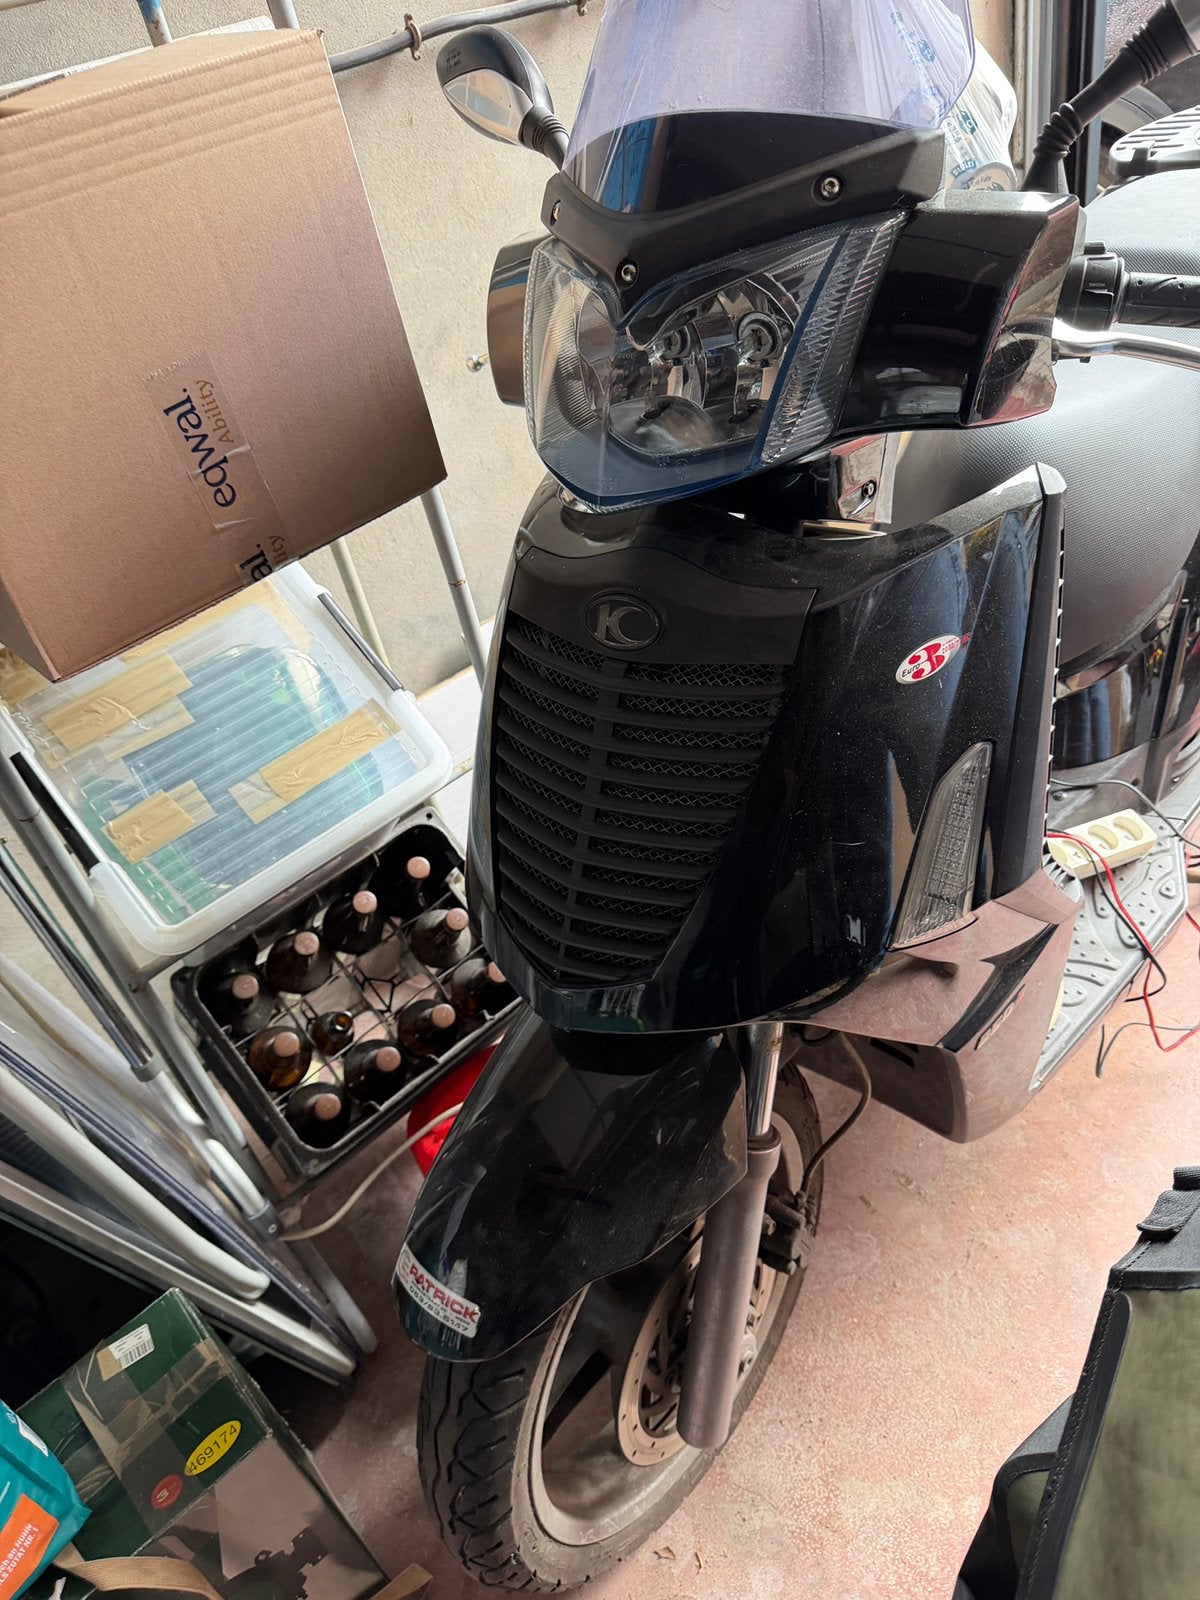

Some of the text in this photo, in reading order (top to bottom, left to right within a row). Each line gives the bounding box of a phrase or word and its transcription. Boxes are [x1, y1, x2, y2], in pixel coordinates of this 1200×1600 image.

[196, 380, 235, 443] Ability
[163, 387, 237, 508] eqwal.
[901, 663, 920, 677] Euro
[409, 1263, 478, 1323] PATRICK
[189, 1424, 237, 1473] 469174
[7, 1548, 17, 1560] an
[15, 1523, 33, 1547] HUHN
[7, 1546, 26, 1572] ZUTAT
[23, 1534, 36, 1547] NR.
